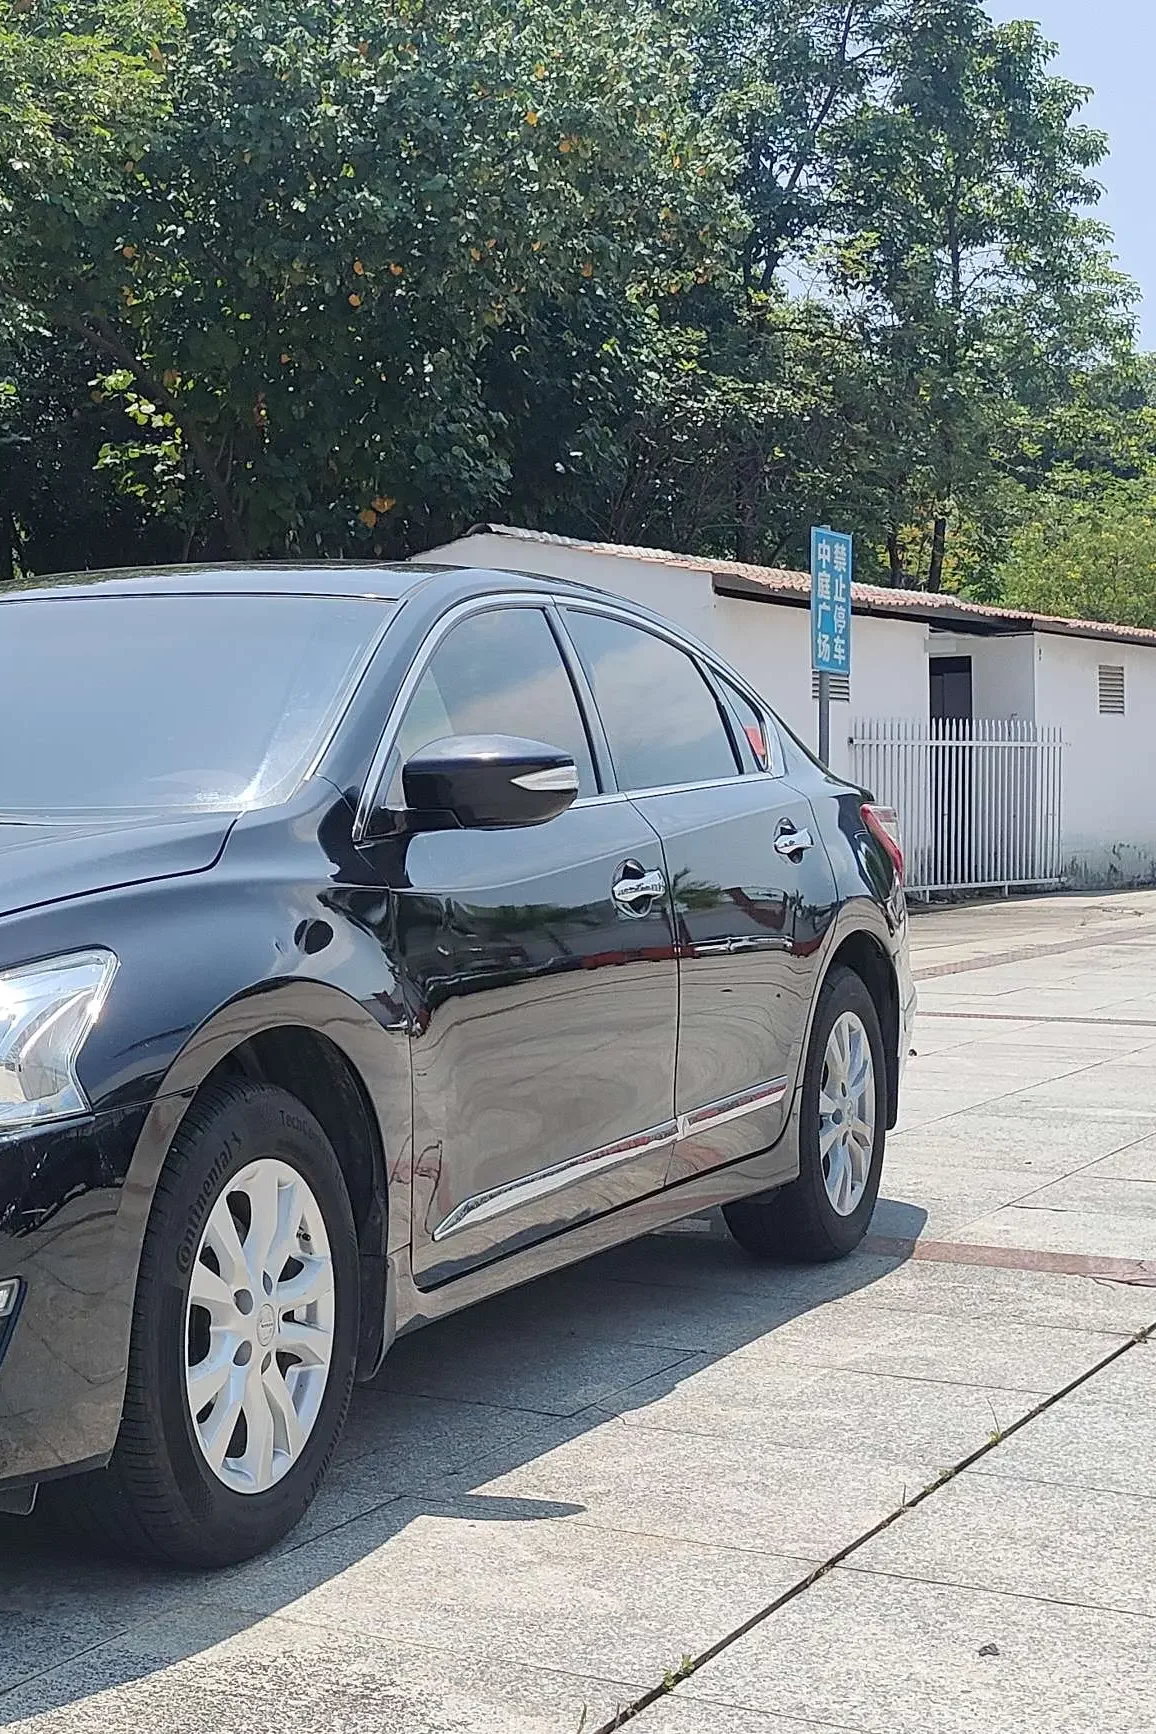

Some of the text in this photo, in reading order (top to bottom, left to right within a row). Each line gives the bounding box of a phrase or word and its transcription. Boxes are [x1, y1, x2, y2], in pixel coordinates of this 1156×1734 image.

[817, 539, 831, 663] 中庭广场
[833, 542, 846, 665] 禁止停车
[176, 1140, 233, 1274] Continental
